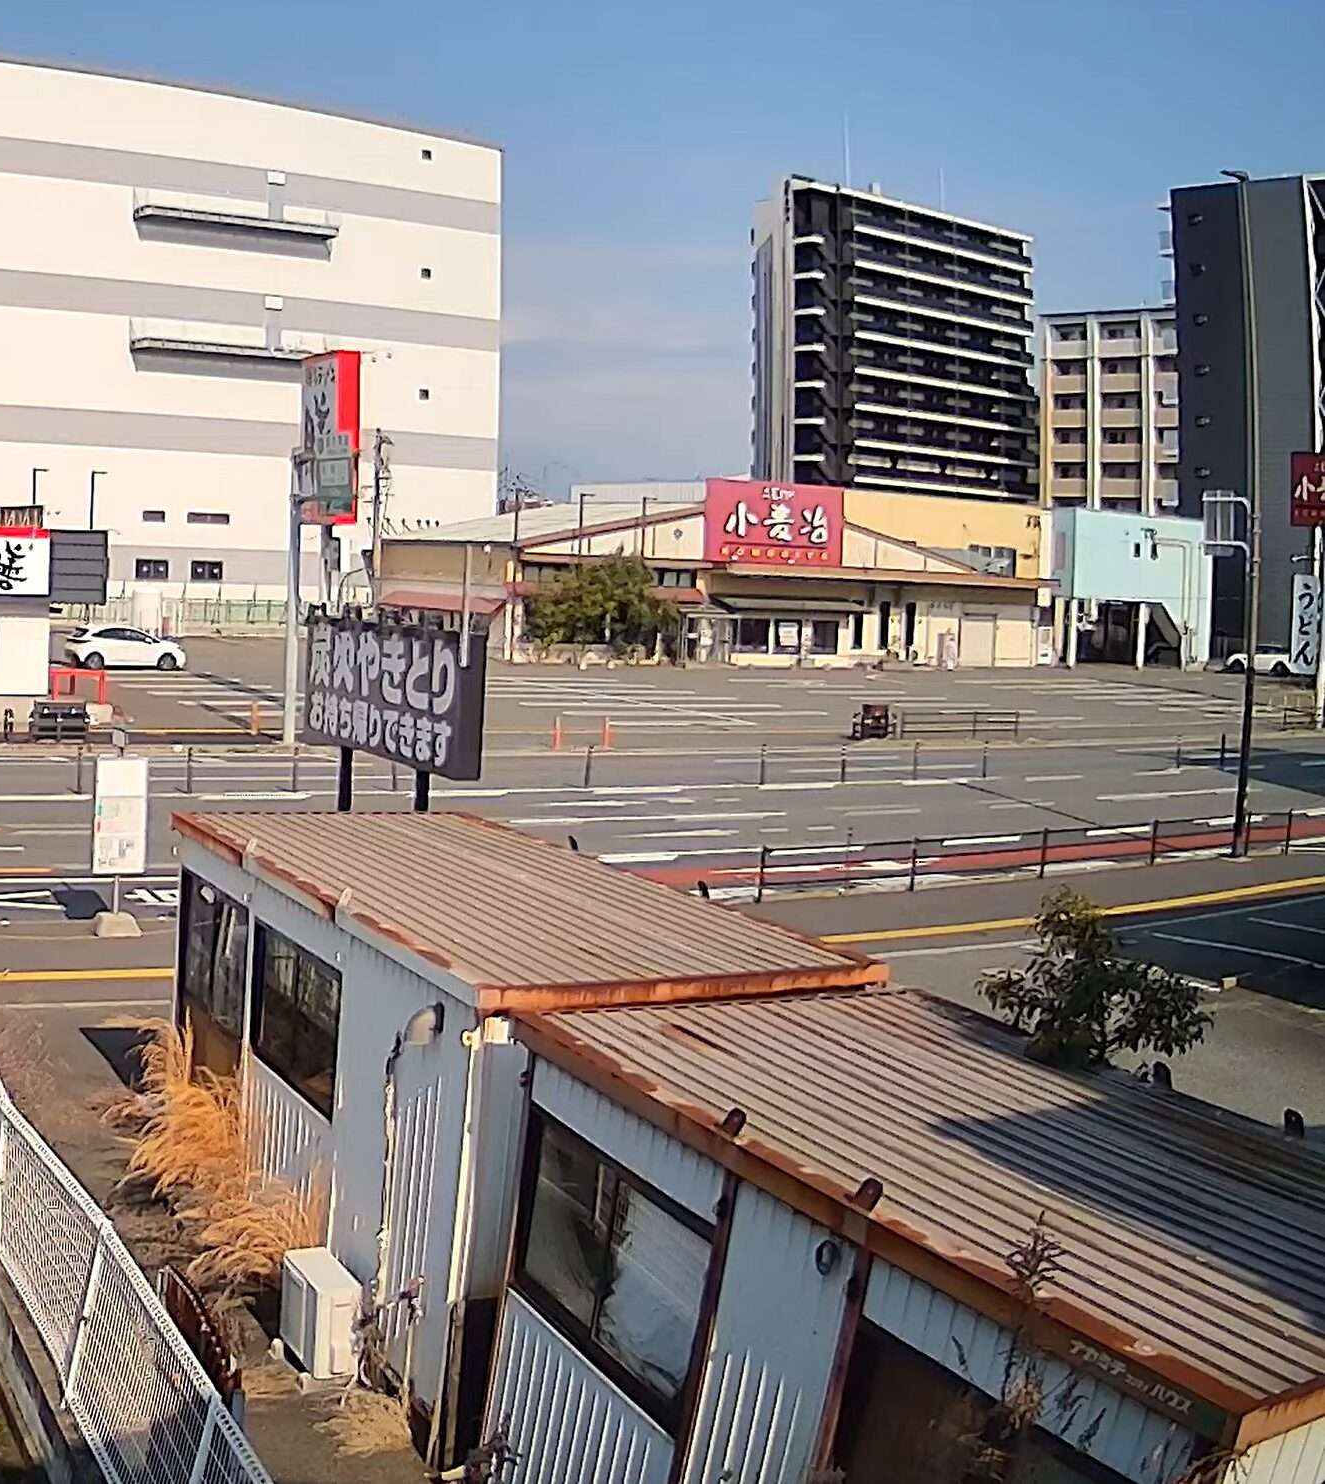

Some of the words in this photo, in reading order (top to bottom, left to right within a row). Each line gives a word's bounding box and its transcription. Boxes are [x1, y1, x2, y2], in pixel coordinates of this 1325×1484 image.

[1294, 582, 1315, 667] うどん
[309, 622, 455, 715] 炭火やきとり
[309, 690, 453, 767] お持ち帰りできます
